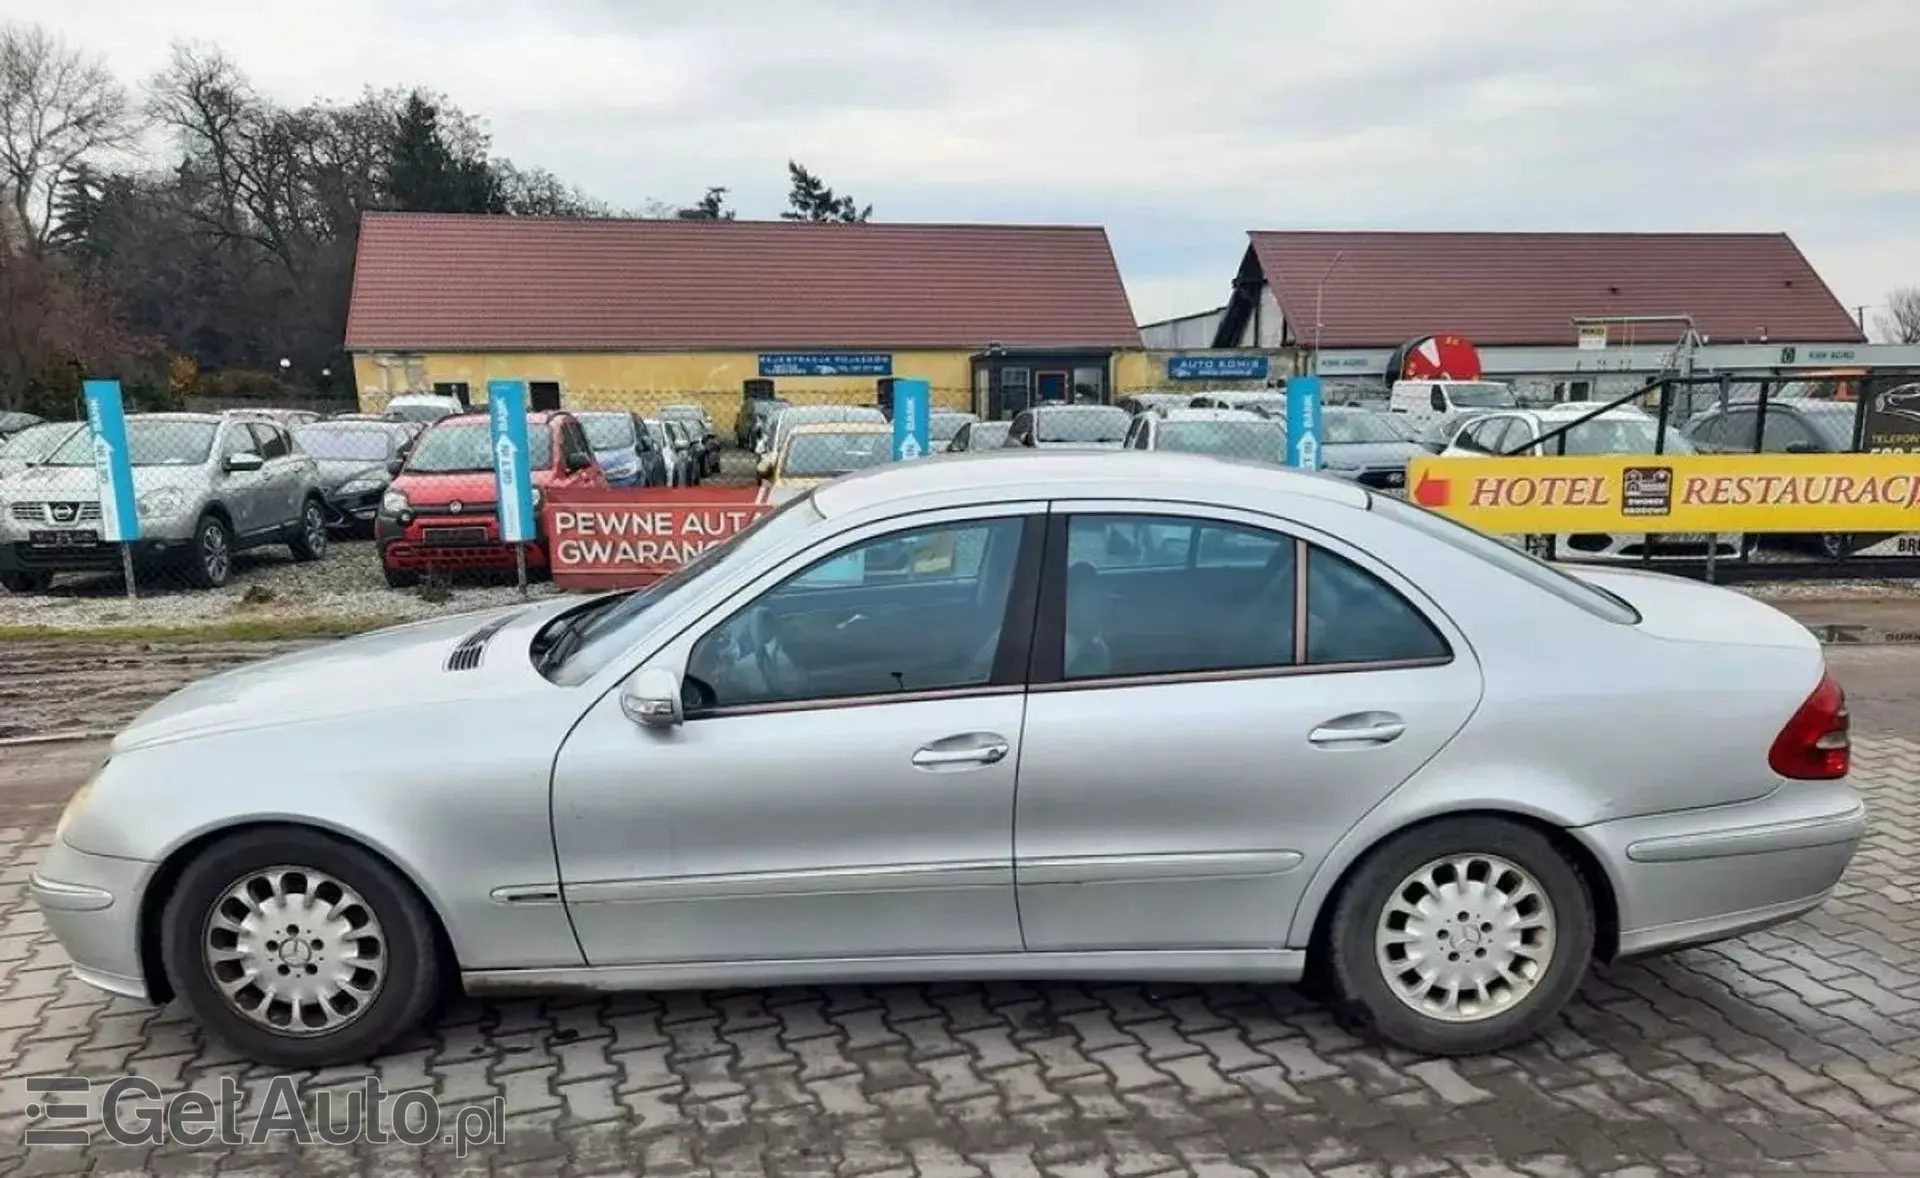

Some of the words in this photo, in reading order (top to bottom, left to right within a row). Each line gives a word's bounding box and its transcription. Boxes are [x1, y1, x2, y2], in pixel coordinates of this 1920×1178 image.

[1180, 359, 1214, 368] AUTO
[89, 397, 103, 431] BANK
[494, 396, 509, 431] BANK
[905, 397, 915, 430] BANK
[1303, 394, 1314, 428] BANK
[502, 460, 513, 485] GET
[1469, 476, 1610, 506] HOTEL
[1682, 475, 1920, 509] RESTAURACJ
[556, 512, 673, 535] PEWNE
[1897, 537, 1920, 553] BR
